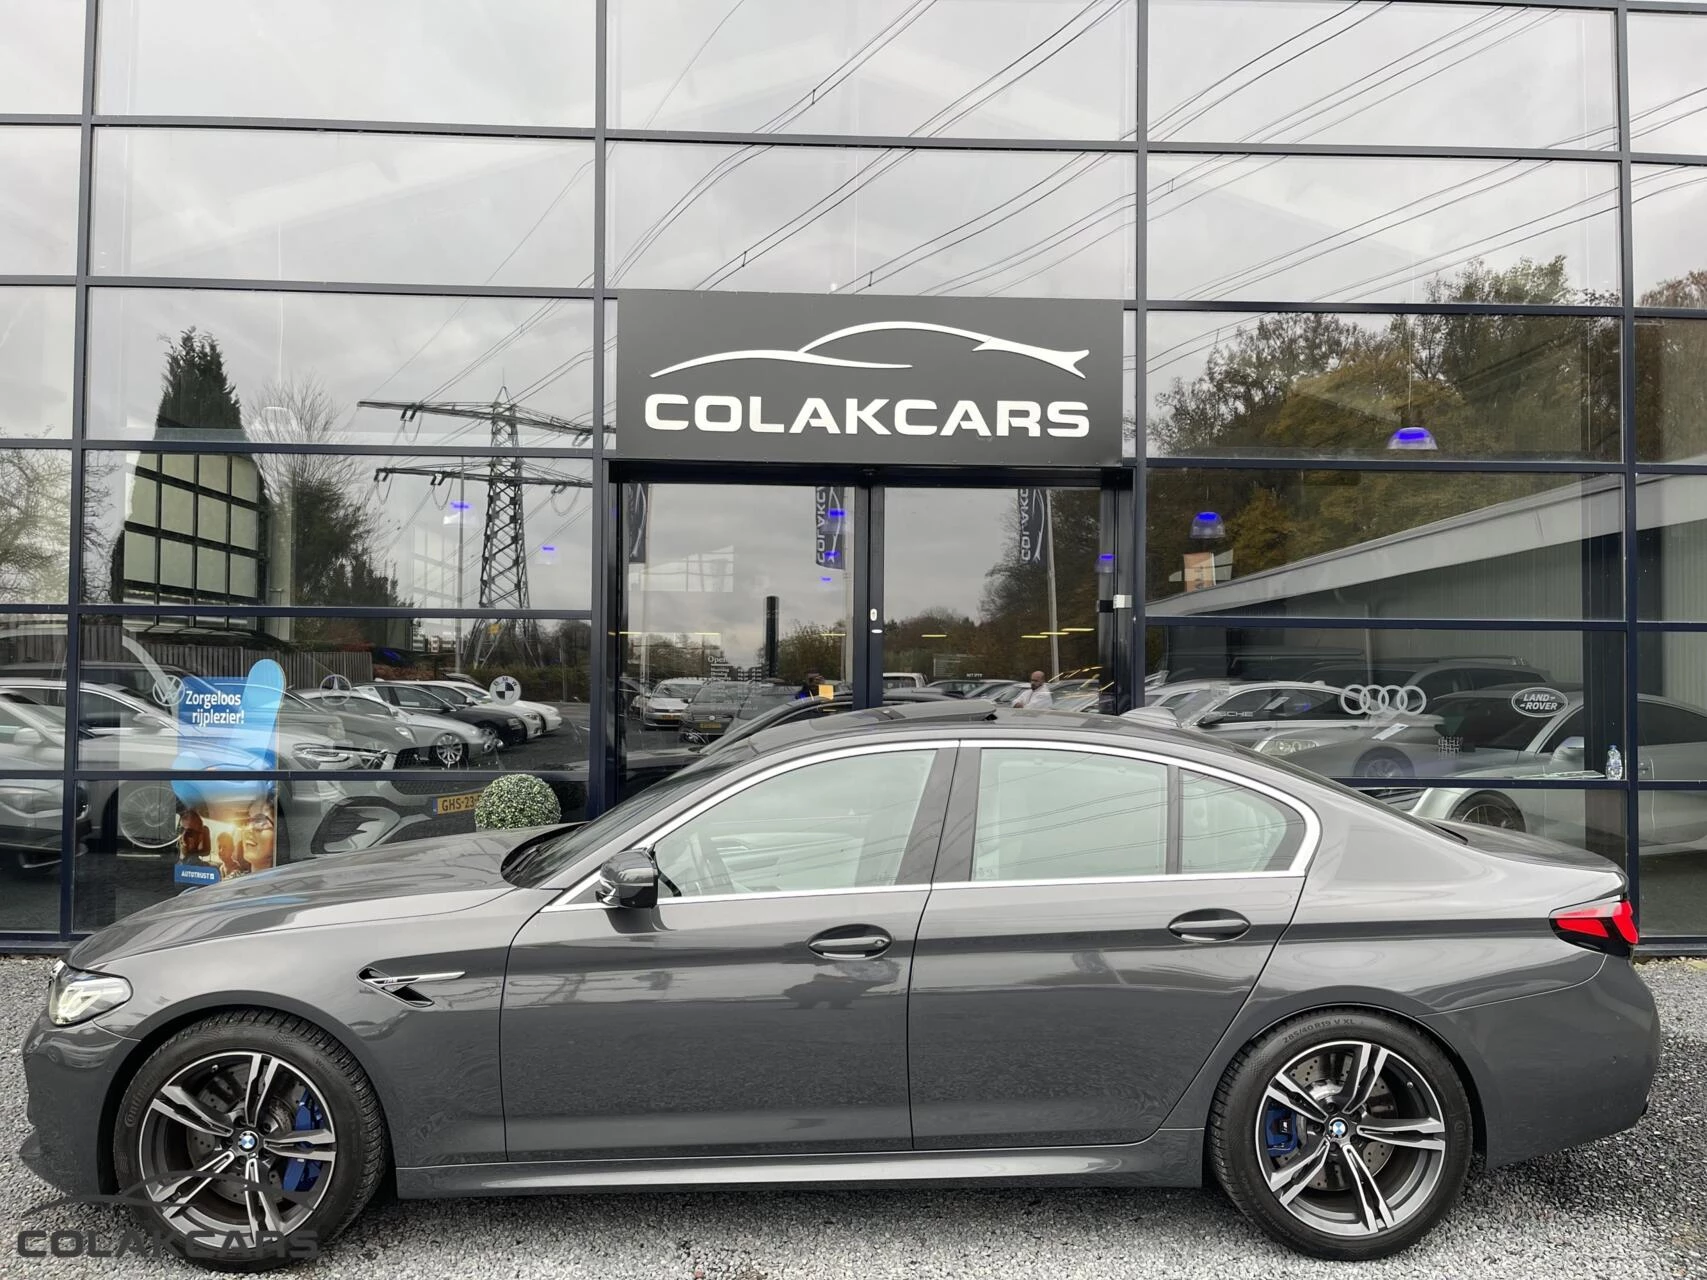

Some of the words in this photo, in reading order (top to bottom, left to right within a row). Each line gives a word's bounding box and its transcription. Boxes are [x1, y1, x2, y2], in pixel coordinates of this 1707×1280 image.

[645, 393, 1090, 437] COLAKCARS
[186, 690, 241, 707] Zorgeloos
[192, 709, 245, 727] rijplezier!
